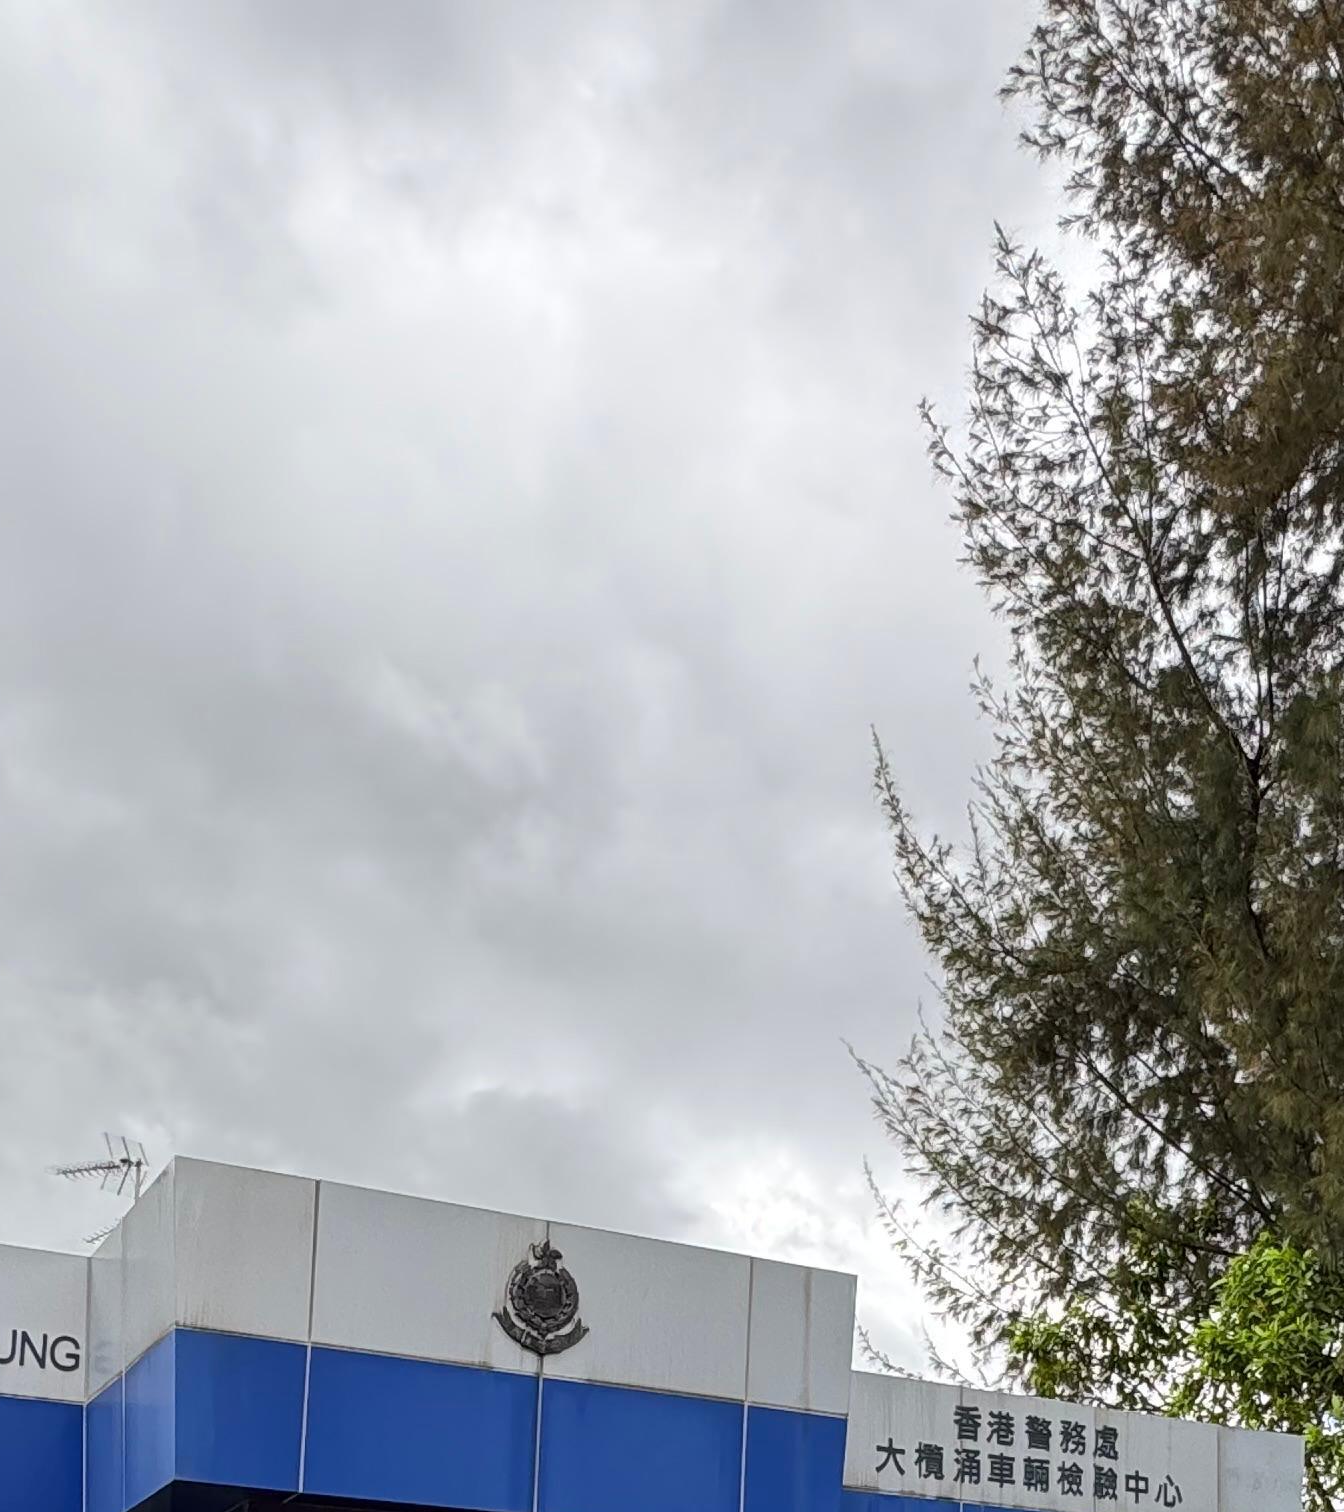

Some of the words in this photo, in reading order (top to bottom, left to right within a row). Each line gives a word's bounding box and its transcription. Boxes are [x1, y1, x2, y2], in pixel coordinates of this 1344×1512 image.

[953, 1405, 1120, 1462] 香港警務處
